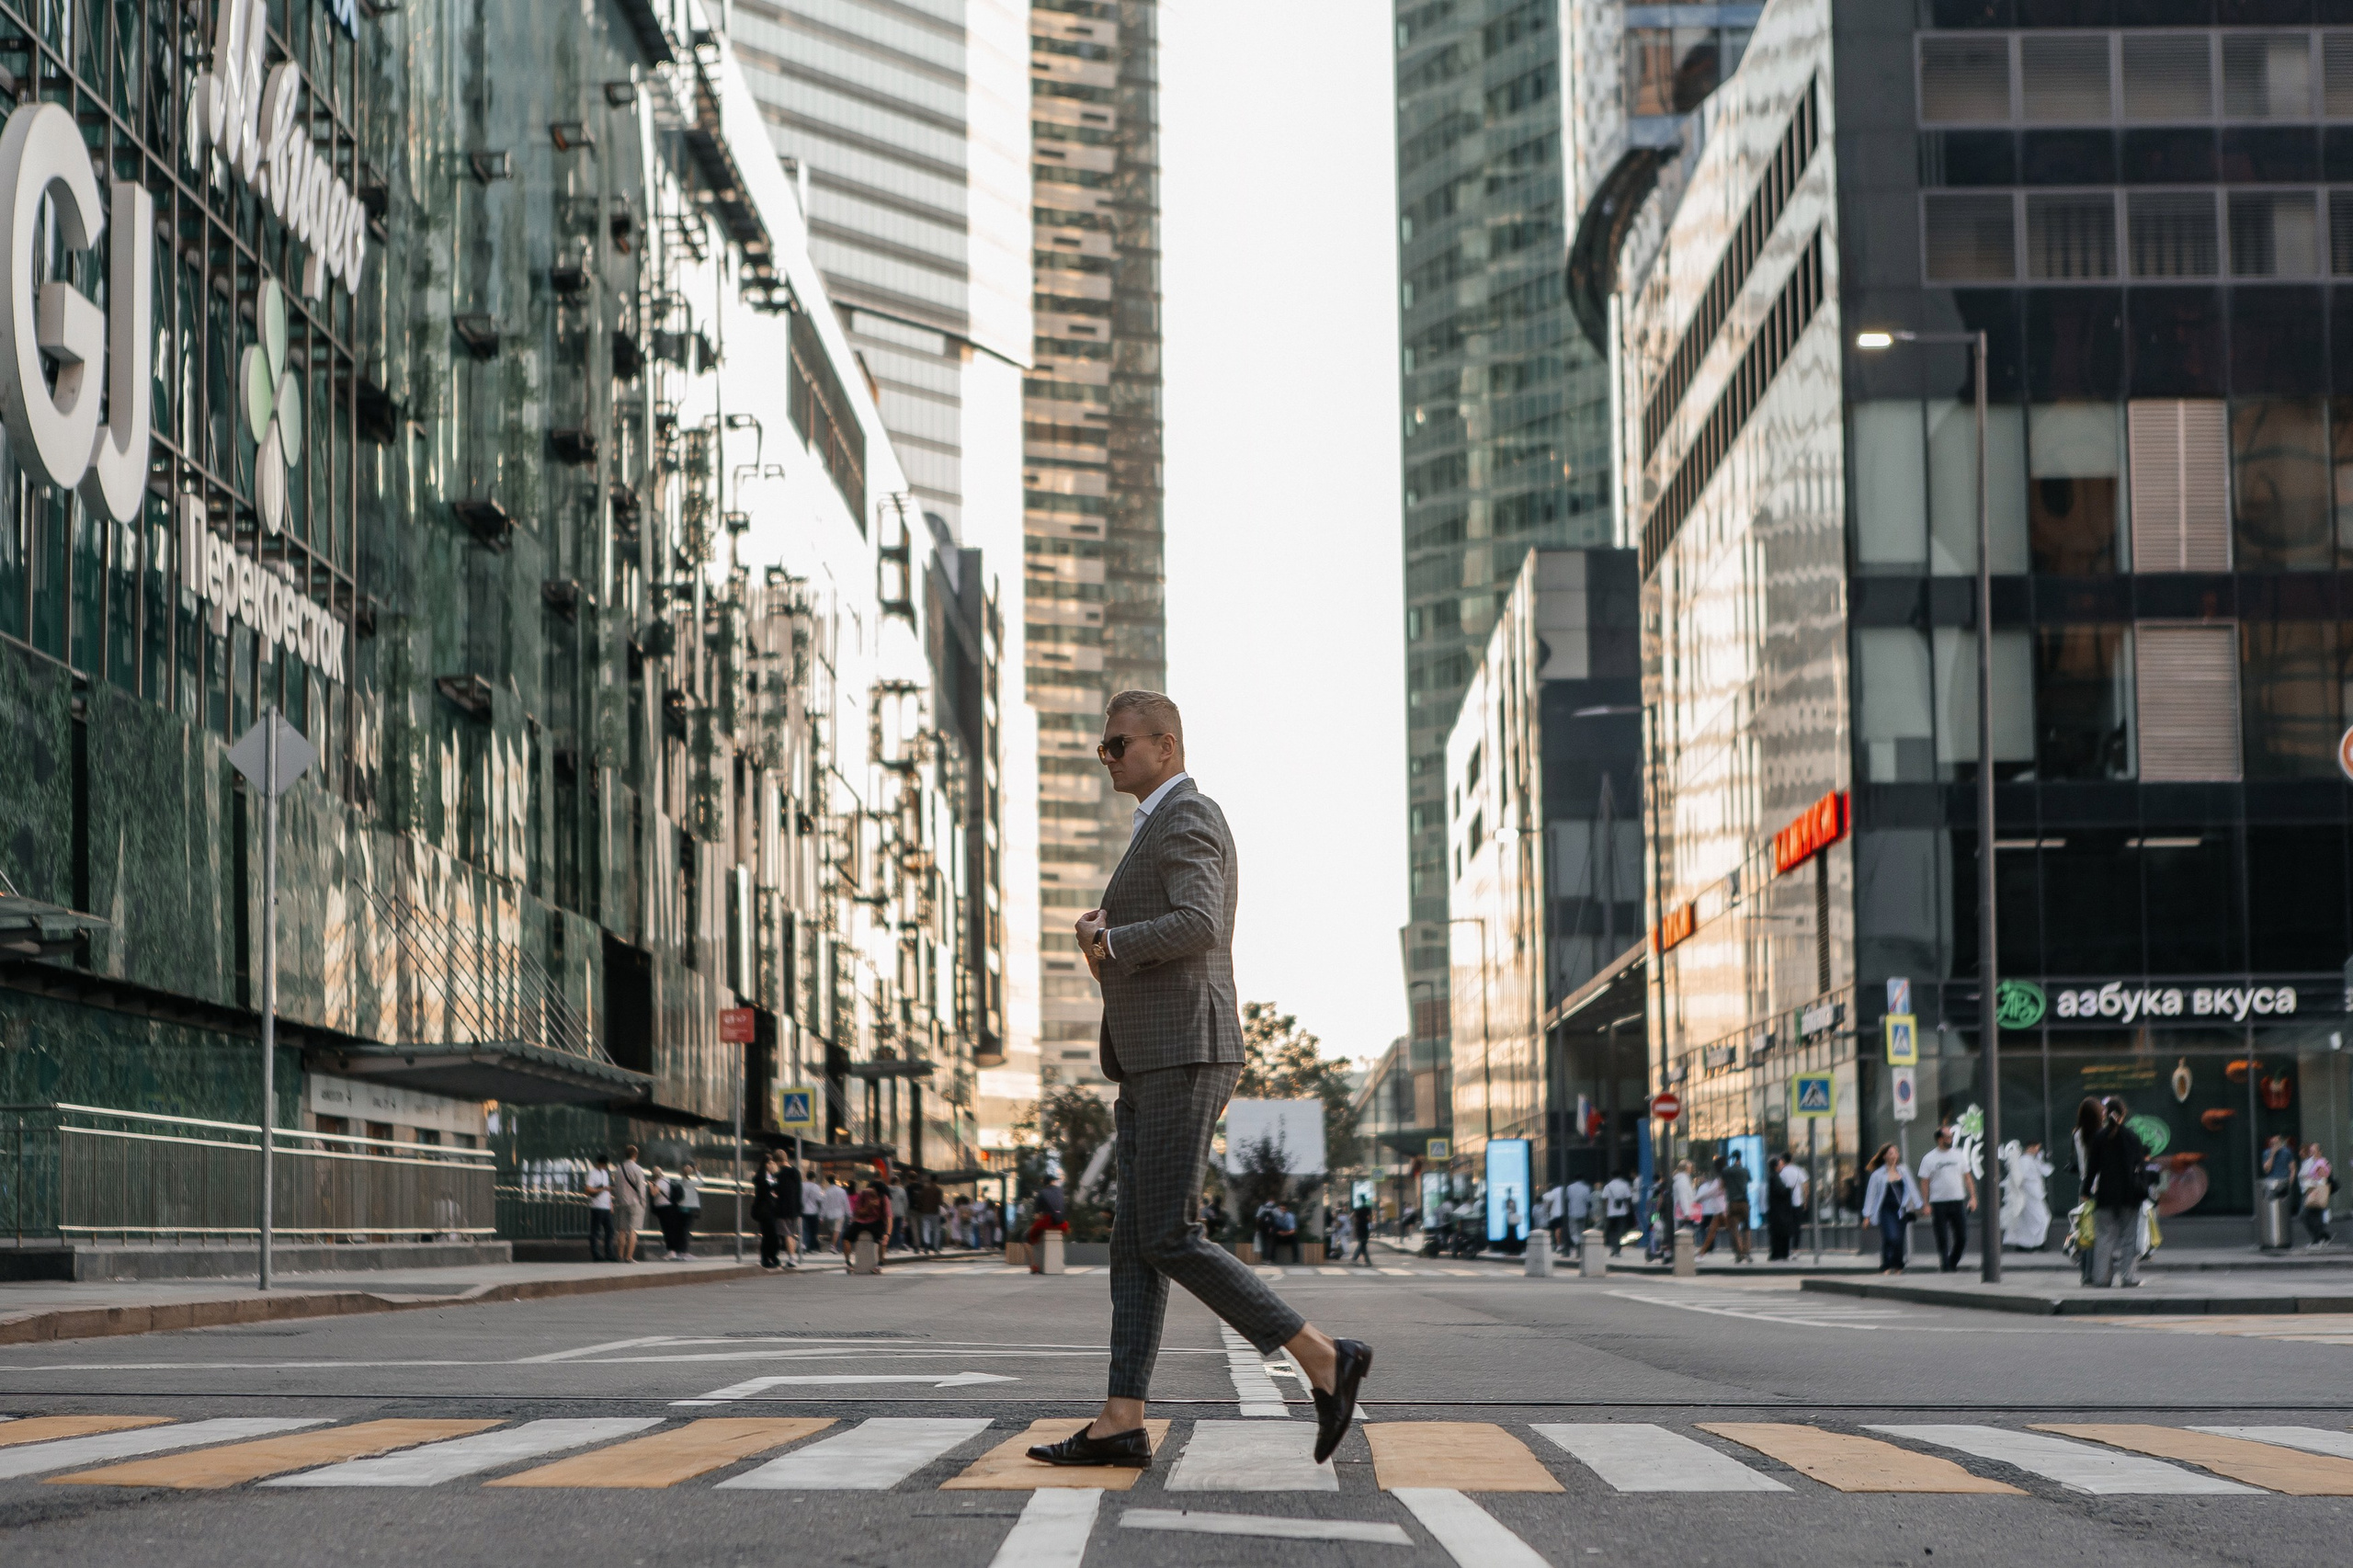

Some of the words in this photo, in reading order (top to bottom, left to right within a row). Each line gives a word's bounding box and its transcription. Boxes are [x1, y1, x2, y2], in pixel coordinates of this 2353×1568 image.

[0, 100, 153, 524] GJ
[181, 494, 345, 685] Перекрёсток
[2056, 981, 2184, 1024] азбука
[2193, 985, 2297, 1022] вкуса
